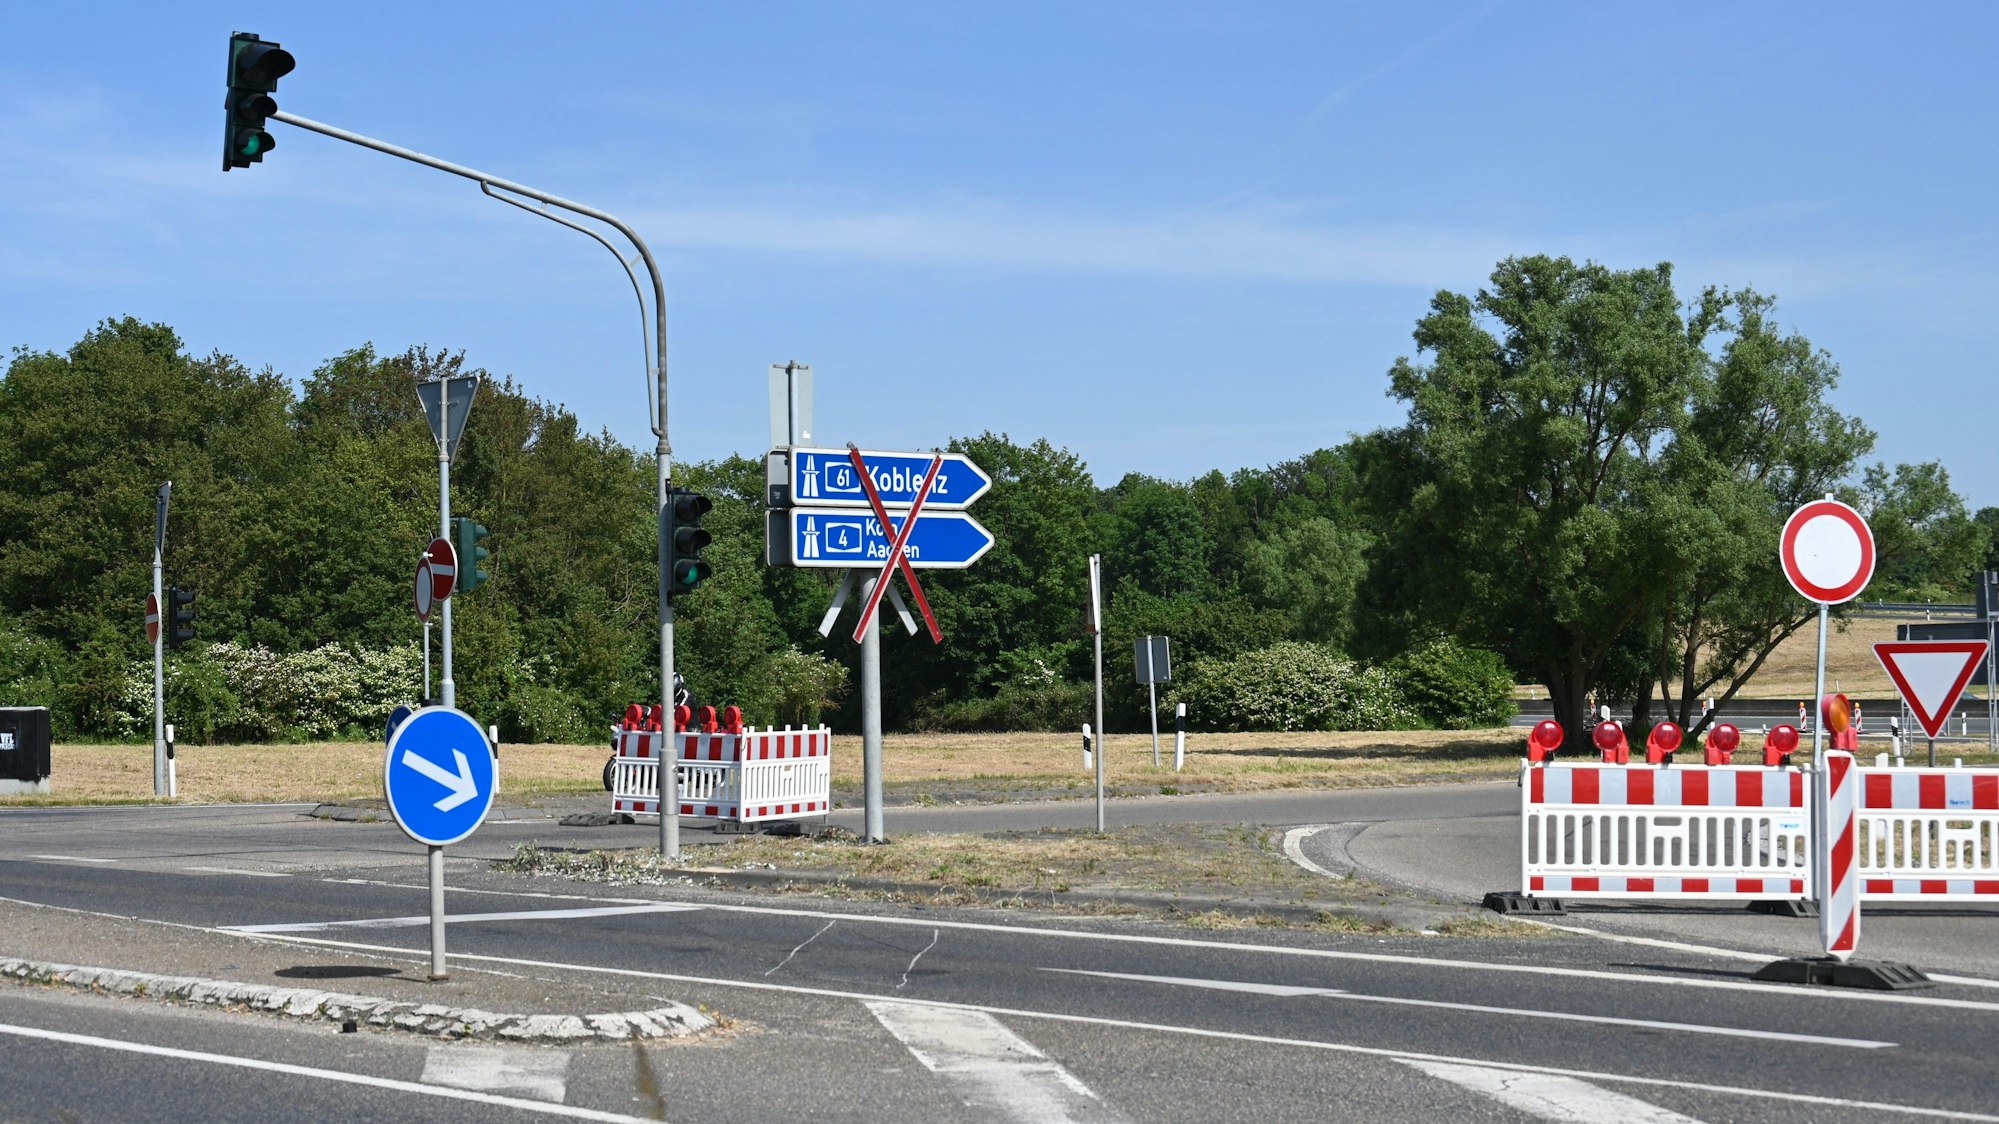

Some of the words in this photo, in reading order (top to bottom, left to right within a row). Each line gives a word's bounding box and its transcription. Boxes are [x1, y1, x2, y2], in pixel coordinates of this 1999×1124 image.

[836, 468, 850, 487] 61
[865, 518, 899, 536] Kn
[838, 529, 848, 547] 4
[866, 540, 920, 559] Aacen
